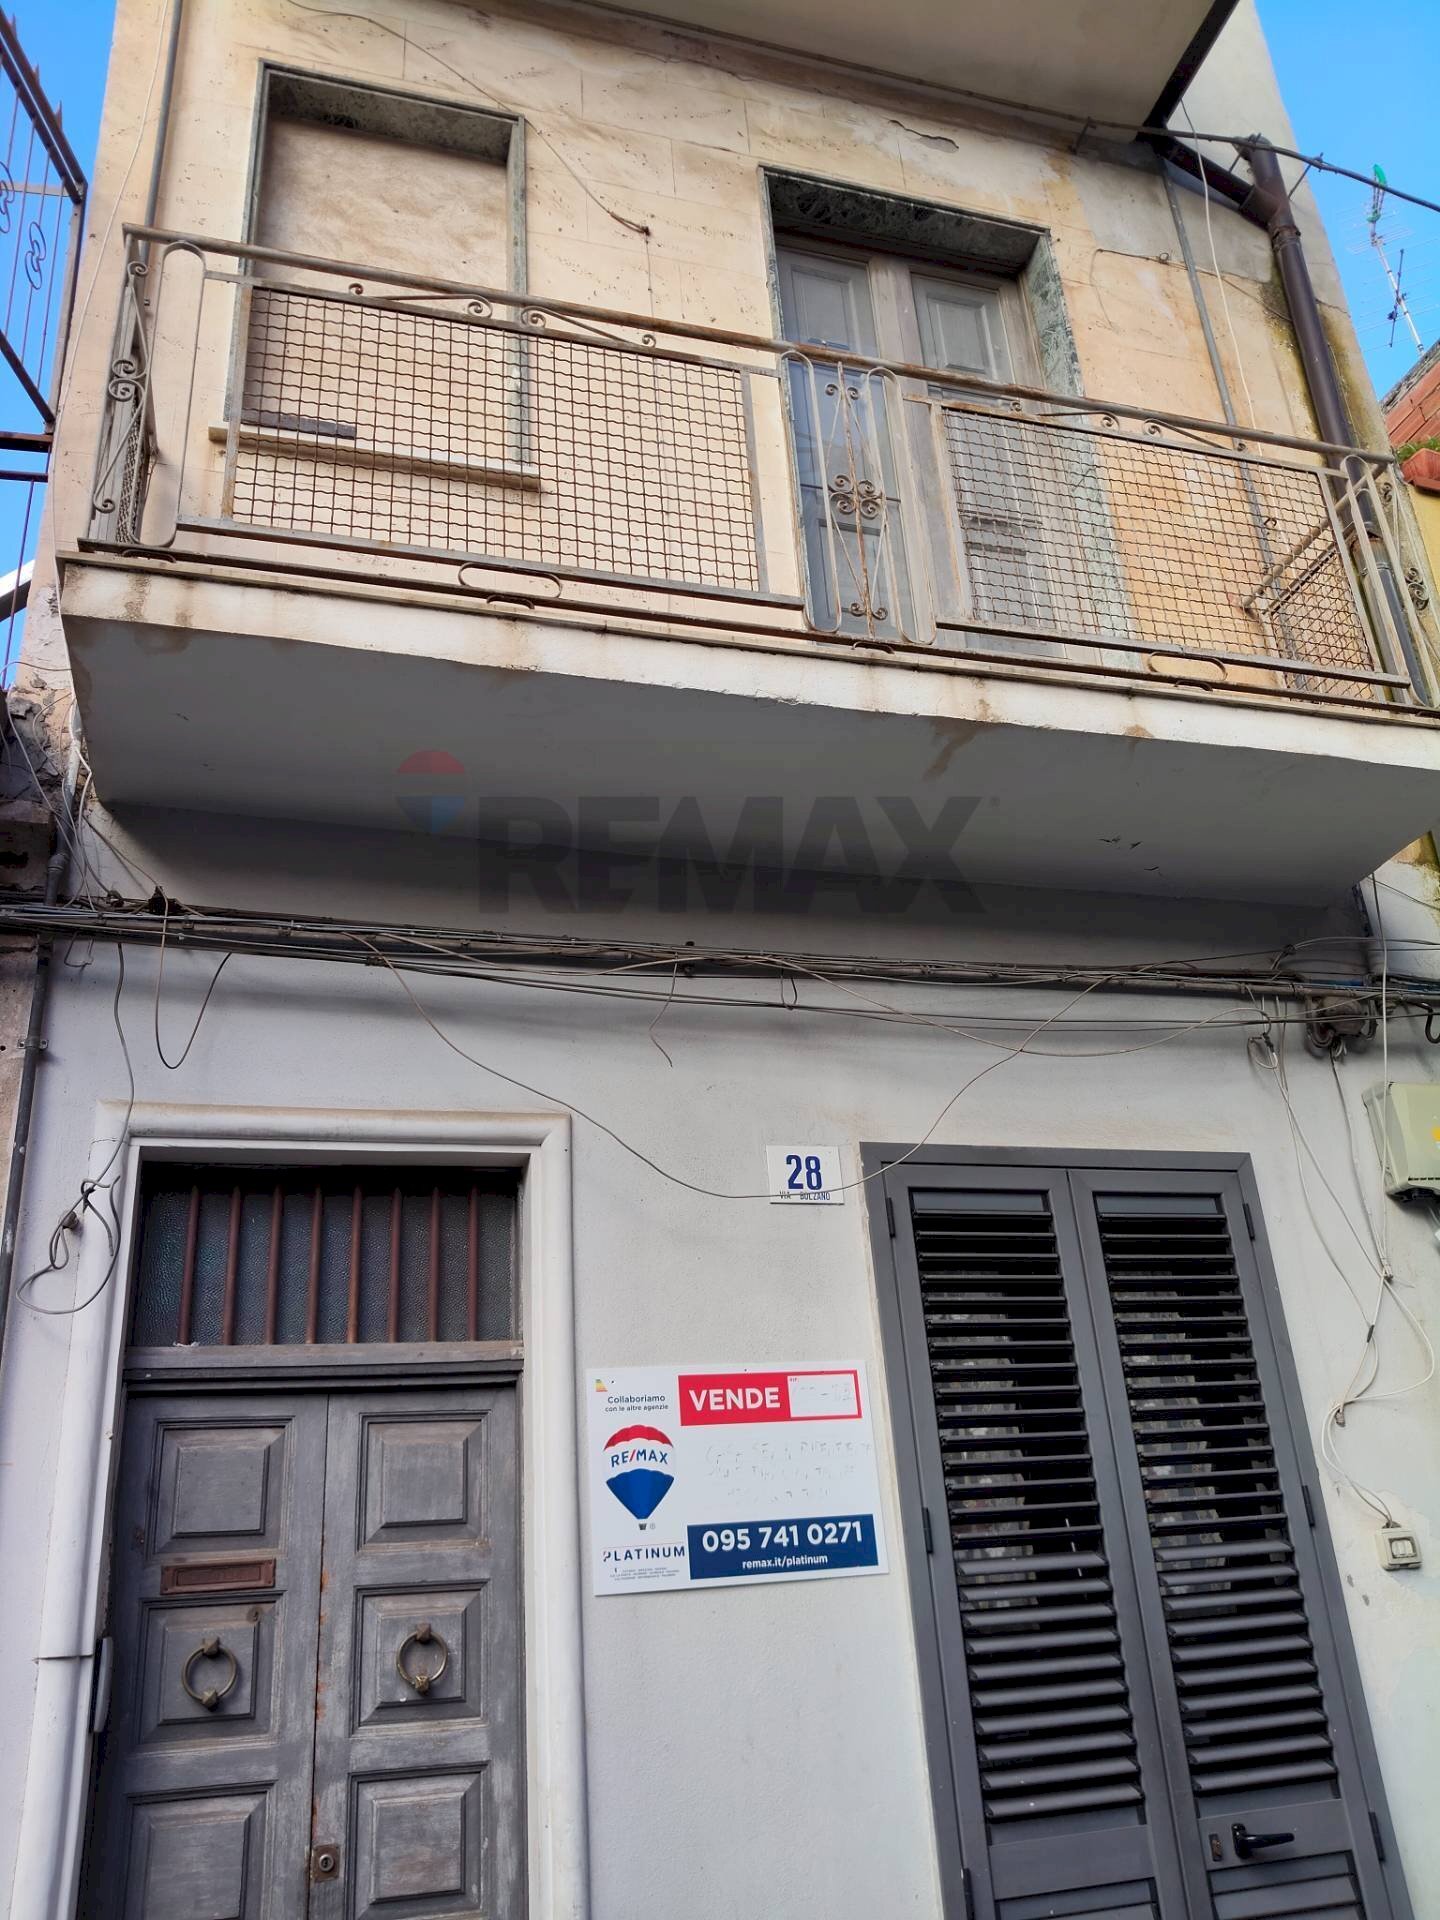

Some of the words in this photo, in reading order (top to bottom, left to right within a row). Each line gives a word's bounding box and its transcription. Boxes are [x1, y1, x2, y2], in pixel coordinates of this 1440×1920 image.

[786, 1155, 822, 1190] 28
[607, 1394, 666, 1404] Collaboriamo
[689, 1387, 780, 1411] VENDE
[626, 1404, 641, 1412] altre
[643, 1404, 669, 1412] agenzie
[611, 1449, 668, 1467] RE/MAX
[702, 1528, 750, 1552] 095
[758, 1525, 799, 1549] 741
[807, 1520, 862, 1545] 0271
[603, 1546, 685, 1562] PLATINUM
[742, 1554, 828, 1569] remax.it/platinum
